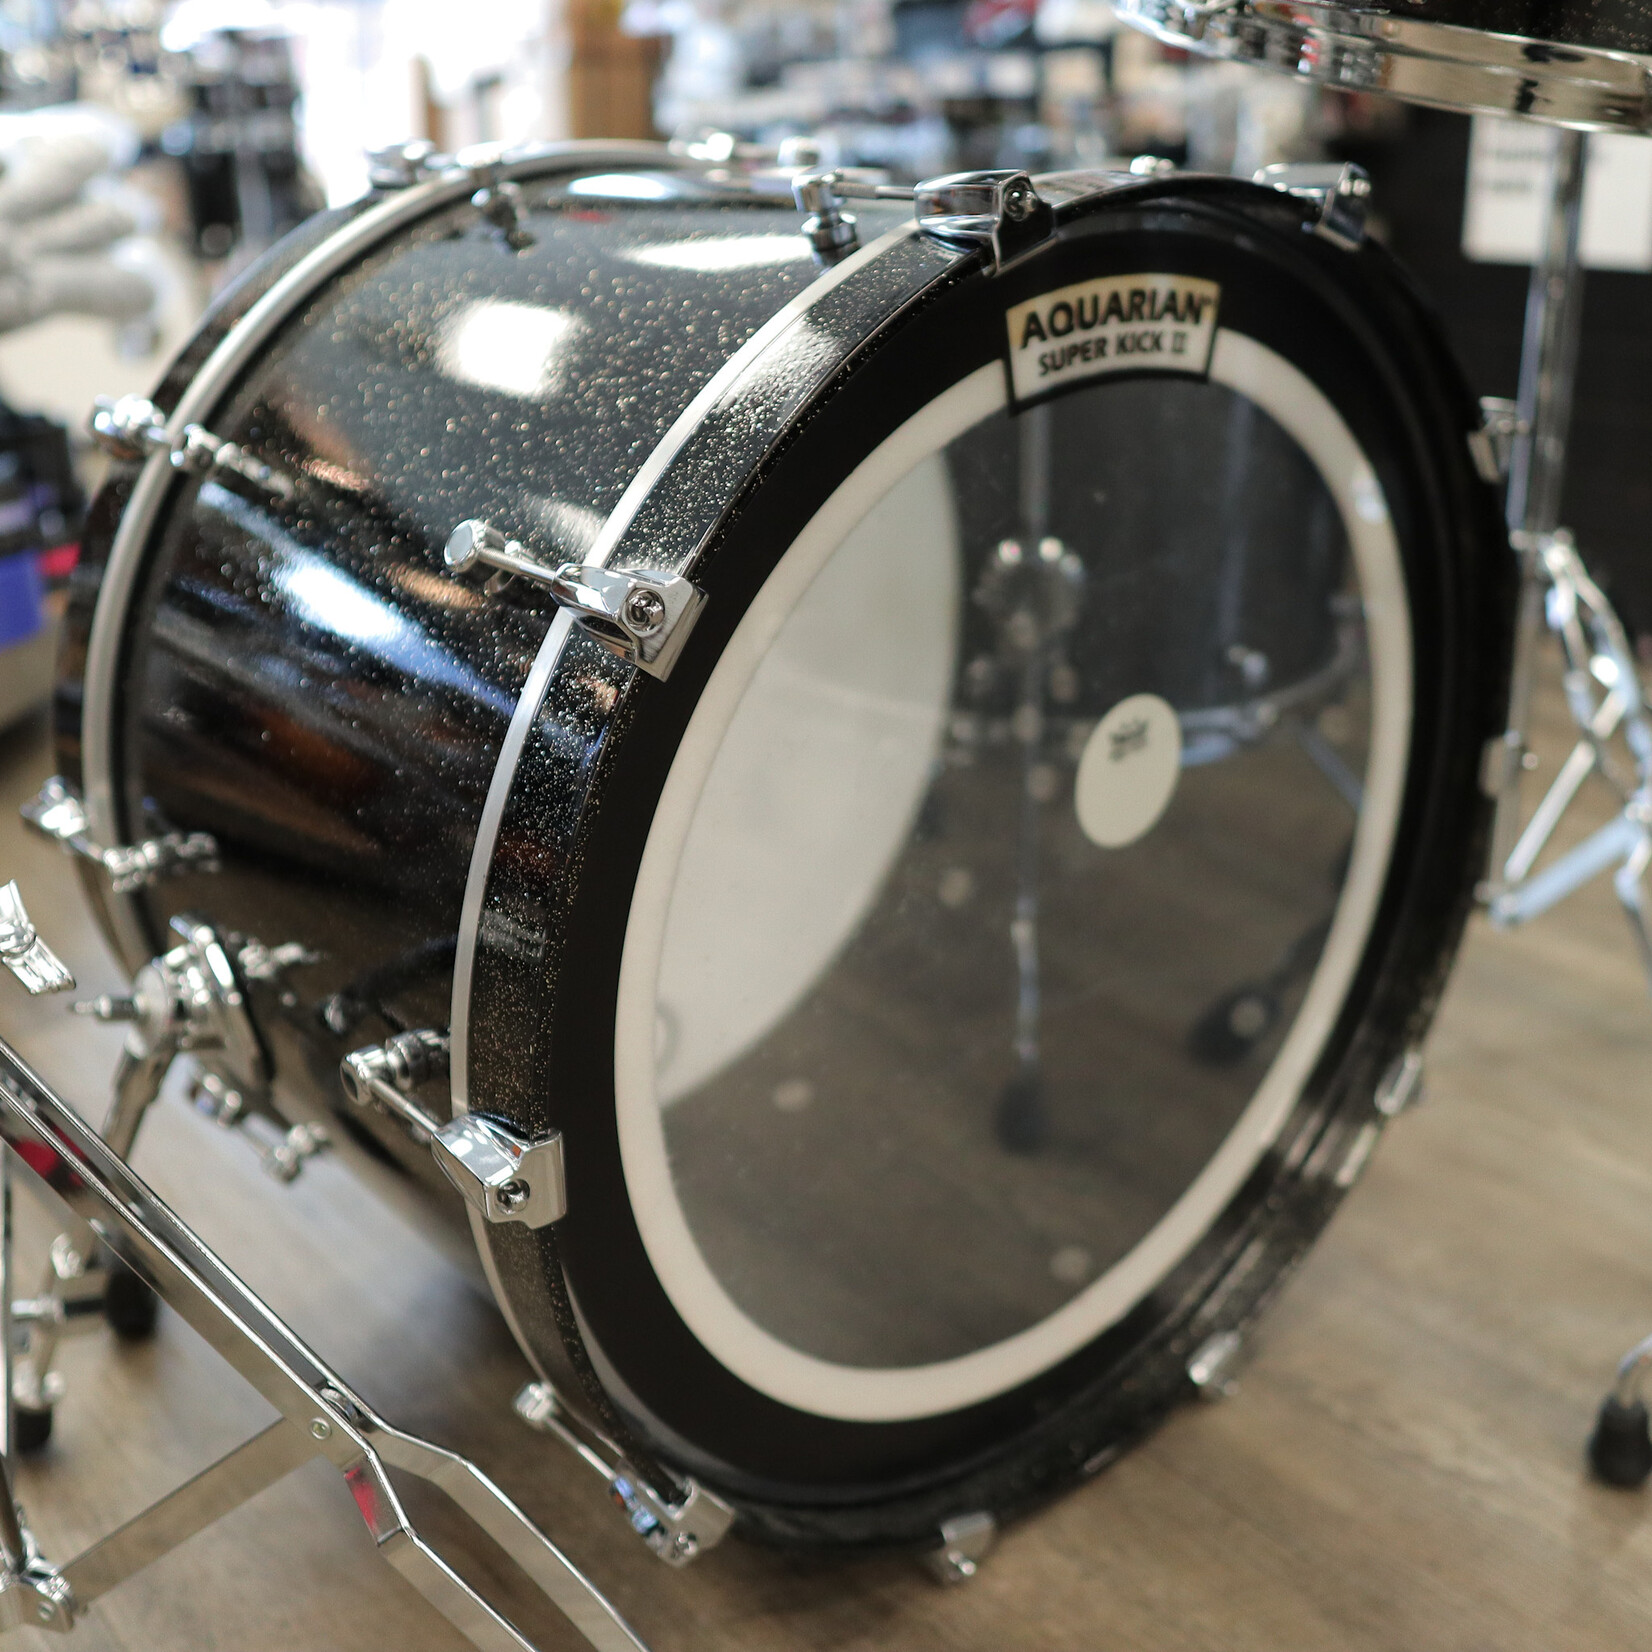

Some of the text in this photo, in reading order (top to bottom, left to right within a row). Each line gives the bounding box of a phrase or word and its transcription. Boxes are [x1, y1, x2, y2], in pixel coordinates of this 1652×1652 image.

[1038, 330, 1187, 376] SUPER KICK II
